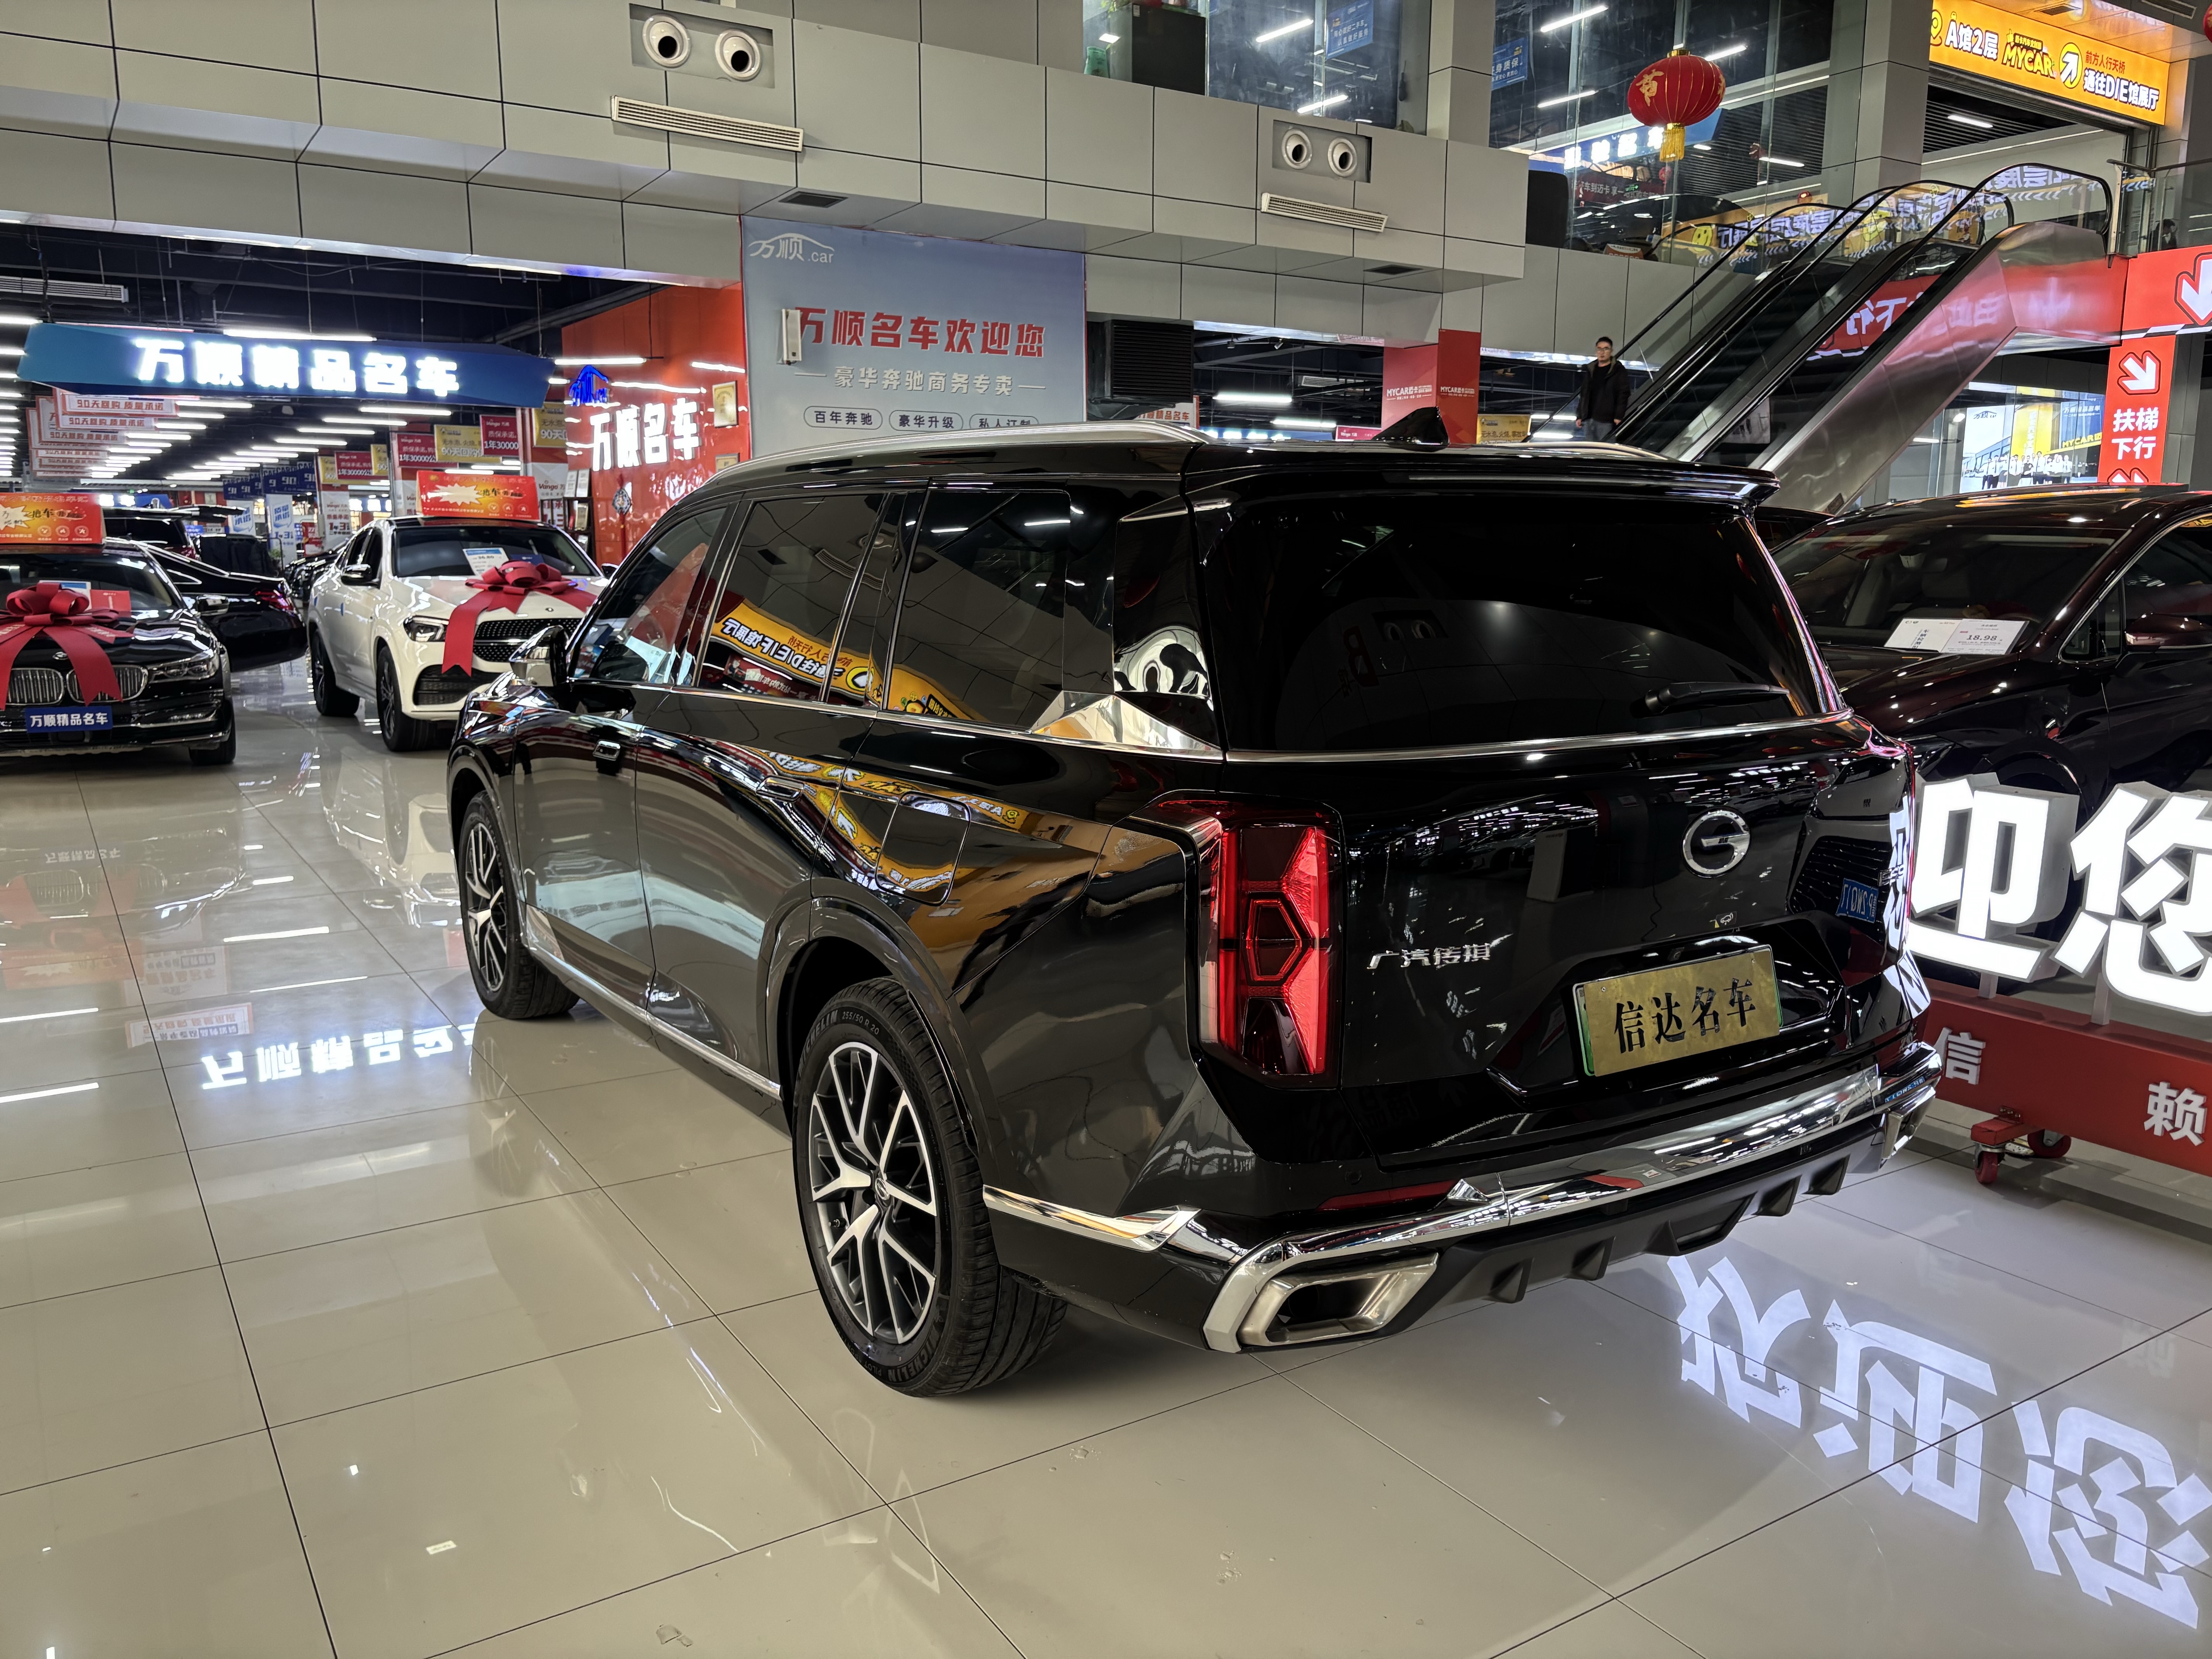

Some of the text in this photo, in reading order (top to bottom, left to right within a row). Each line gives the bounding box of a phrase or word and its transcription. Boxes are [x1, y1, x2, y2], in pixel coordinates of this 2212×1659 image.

[2001, 43, 2056, 80] MYCAR
[2086, 50, 2126, 74] 前方人行天桥
[795, 307, 1046, 358] 万顺名车欢迎您
[834, 366, 1014, 396] 豪华奔驰商务专卖
[77, 399, 163, 410] 90天回购 质量承诺
[814, 410, 874, 426] 百年奔驰
[898, 414, 955, 429] 豪华升级
[2112, 407, 2158, 433] 扶梯
[590, 398, 699, 472] 万顺名车
[2111, 437, 2156, 460] 下行
[30, 712, 108, 727] 万顺精品名车
[842, 1011, 864, 1024] 255/50
[871, 1024, 880, 1035] 20
[1613, 977, 1757, 1055] 信达名车
[1934, 1026, 2207, 1147] 信 赖
